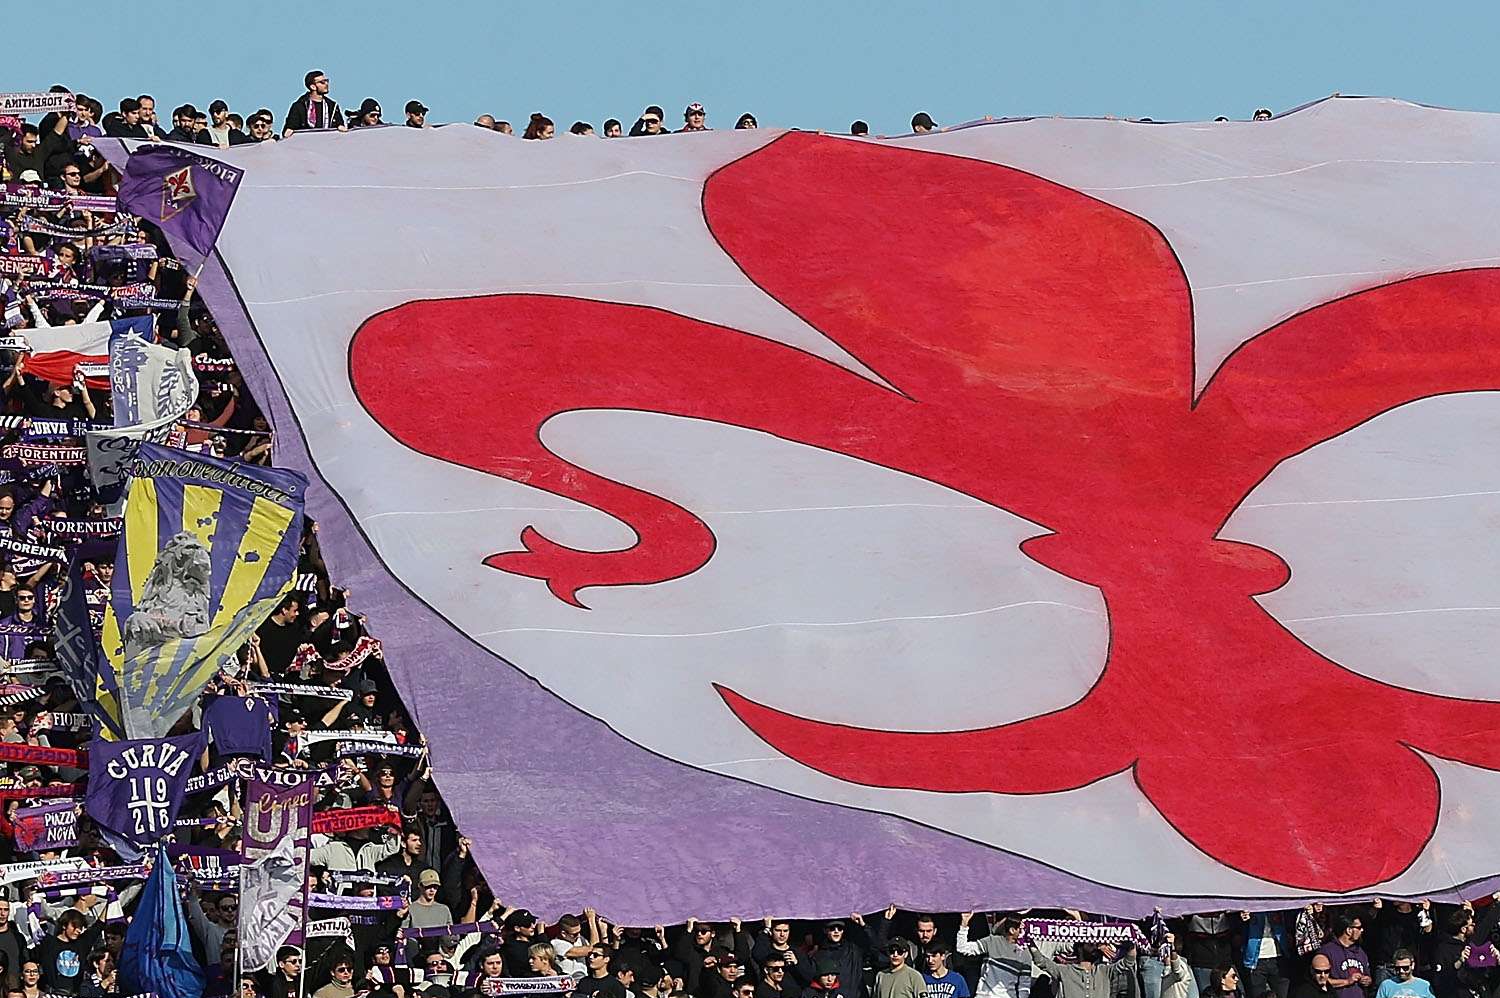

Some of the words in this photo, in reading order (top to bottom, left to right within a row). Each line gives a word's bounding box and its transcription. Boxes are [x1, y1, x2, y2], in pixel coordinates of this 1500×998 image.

[28, 421, 69, 437] CURVA
[106, 743, 191, 780] CURVA
[44, 811, 78, 829] PIAZZA
[47, 826, 77, 841] NOVA
[1029, 925, 1043, 937] la
[1046, 925, 1133, 939] FIORENTINA
